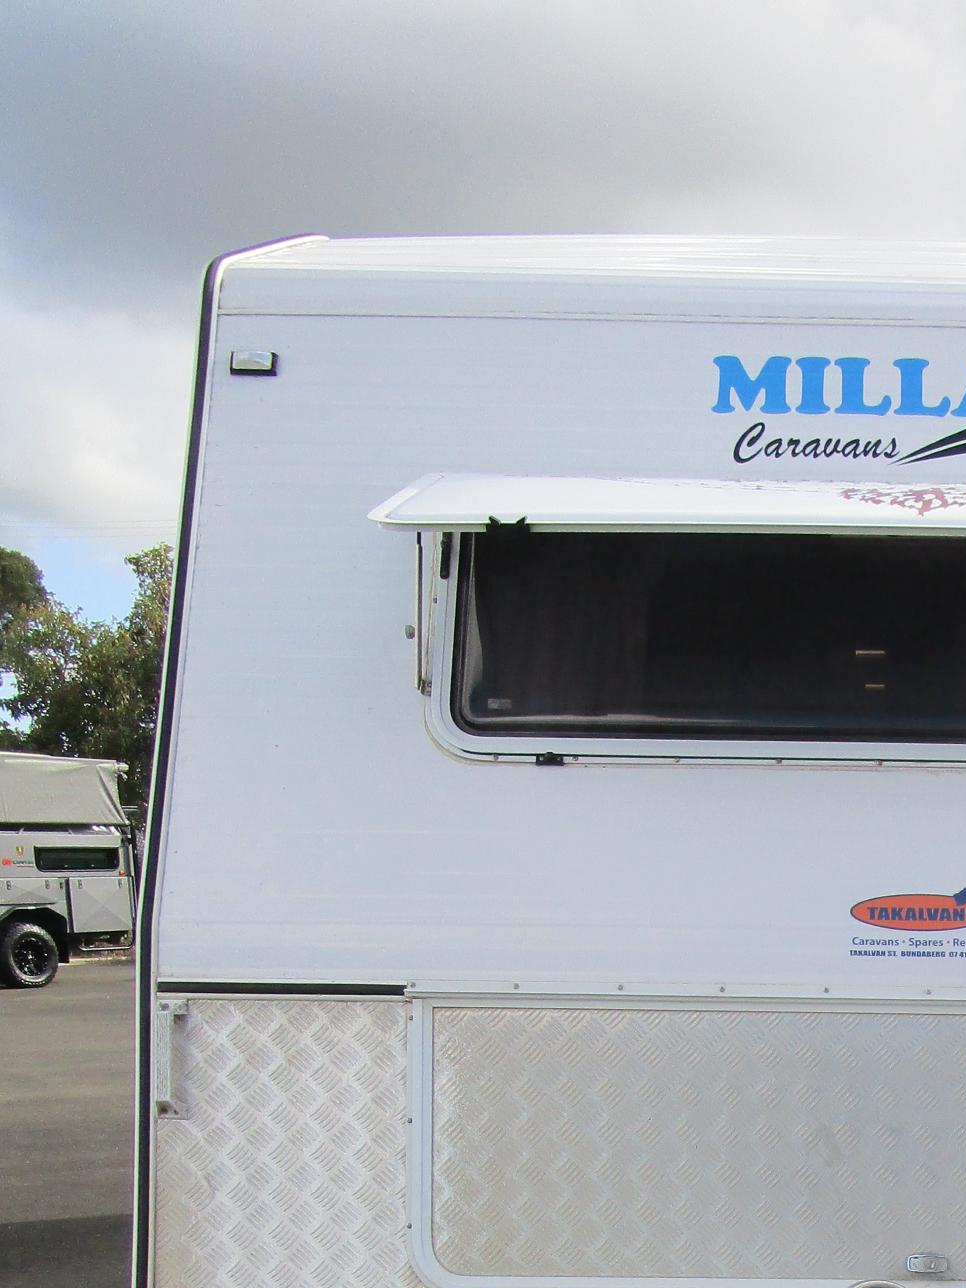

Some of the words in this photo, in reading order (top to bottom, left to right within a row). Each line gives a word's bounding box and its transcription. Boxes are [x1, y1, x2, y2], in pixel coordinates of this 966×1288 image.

[732, 422, 900, 464] Caravans
[851, 936, 899, 946] Caravans
[908, 937, 944, 948] Spares
[849, 949, 886, 957] TAKALVAN
[900, 950, 946, 958] BUNDABERG
